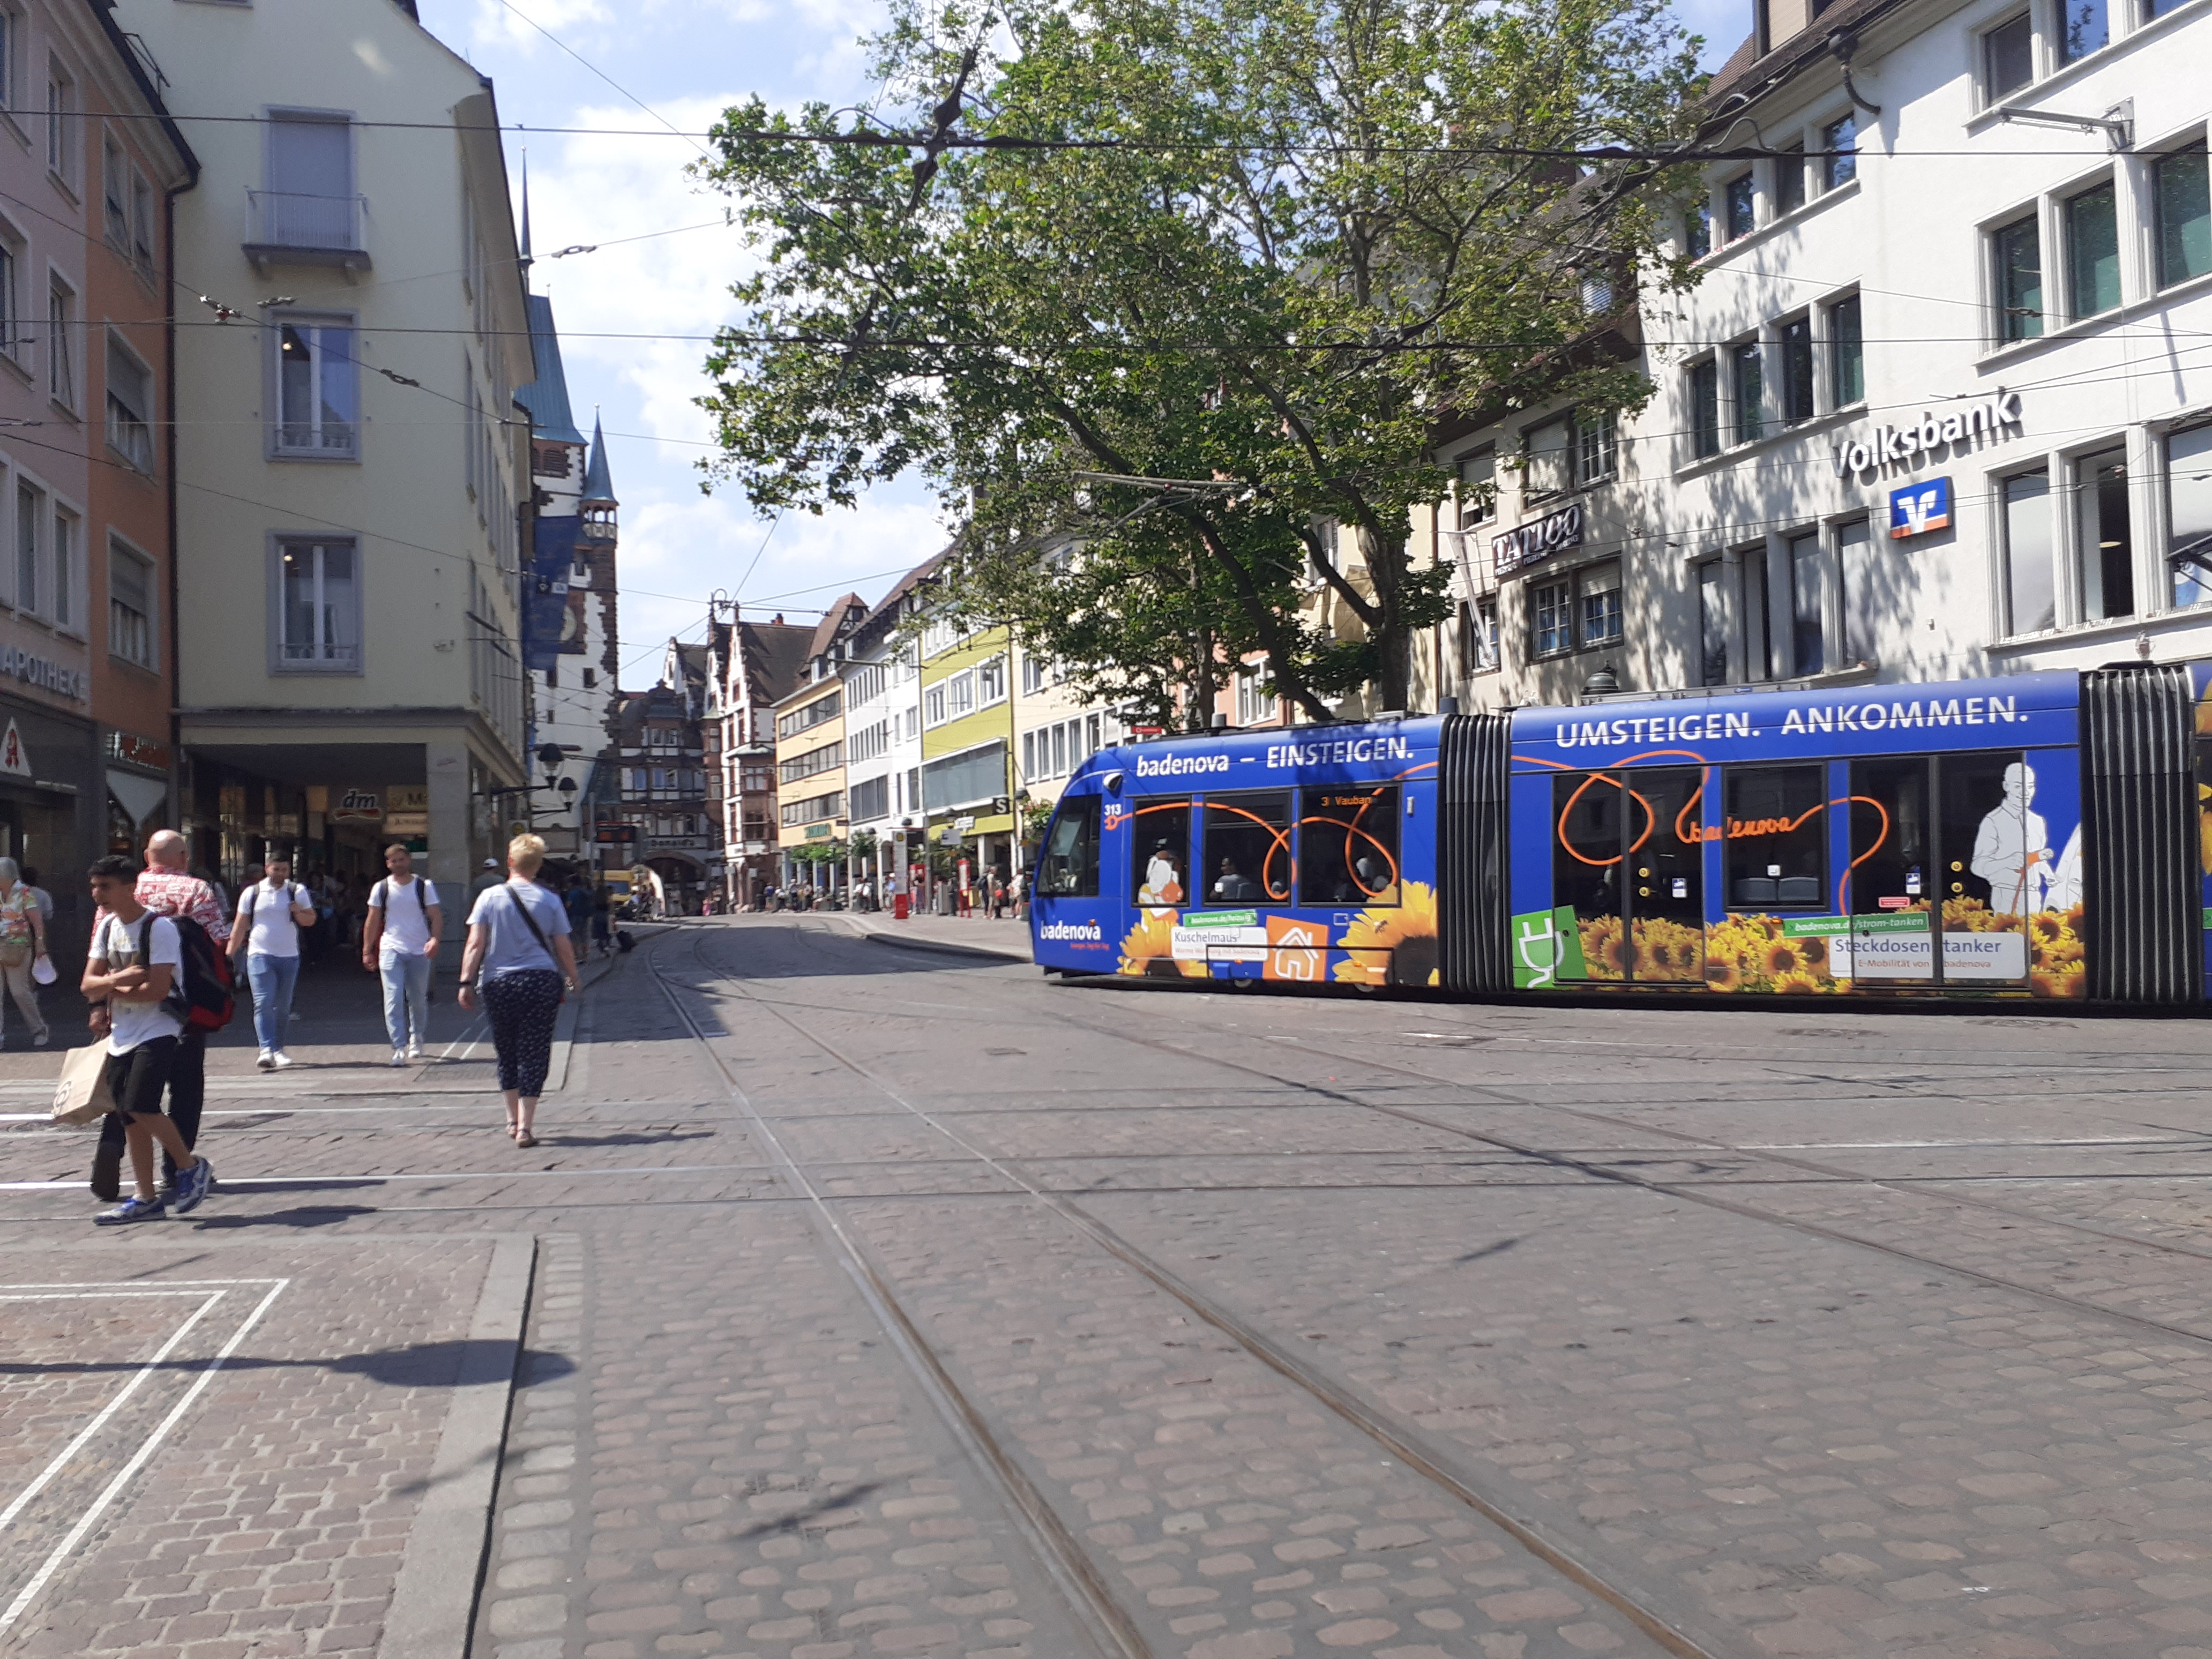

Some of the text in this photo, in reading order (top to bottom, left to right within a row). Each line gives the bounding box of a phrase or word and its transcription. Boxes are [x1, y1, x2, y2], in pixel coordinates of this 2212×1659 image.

[1831, 389, 2021, 477] Volksbank
[1493, 506, 1580, 566] TATTOO
[3, 644, 90, 701] APOTHEKE
[1556, 696, 2028, 748] UMSTEIGEN. ANKOMMEN.
[1137, 752, 1229, 776] badenova
[1267, 736, 1414, 768] EINSTEIGEN.
[342, 790, 376, 809] dm
[1104, 803, 1122, 816] 313
[1321, 796, 1371, 806] 3 Vauban
[1041, 920, 1101, 940] badenova
[1175, 931, 1237, 943] Kuschelmaus
[1858, 959, 1910, 968] E-Mobilität
[1944, 959, 1991, 968] badenova
